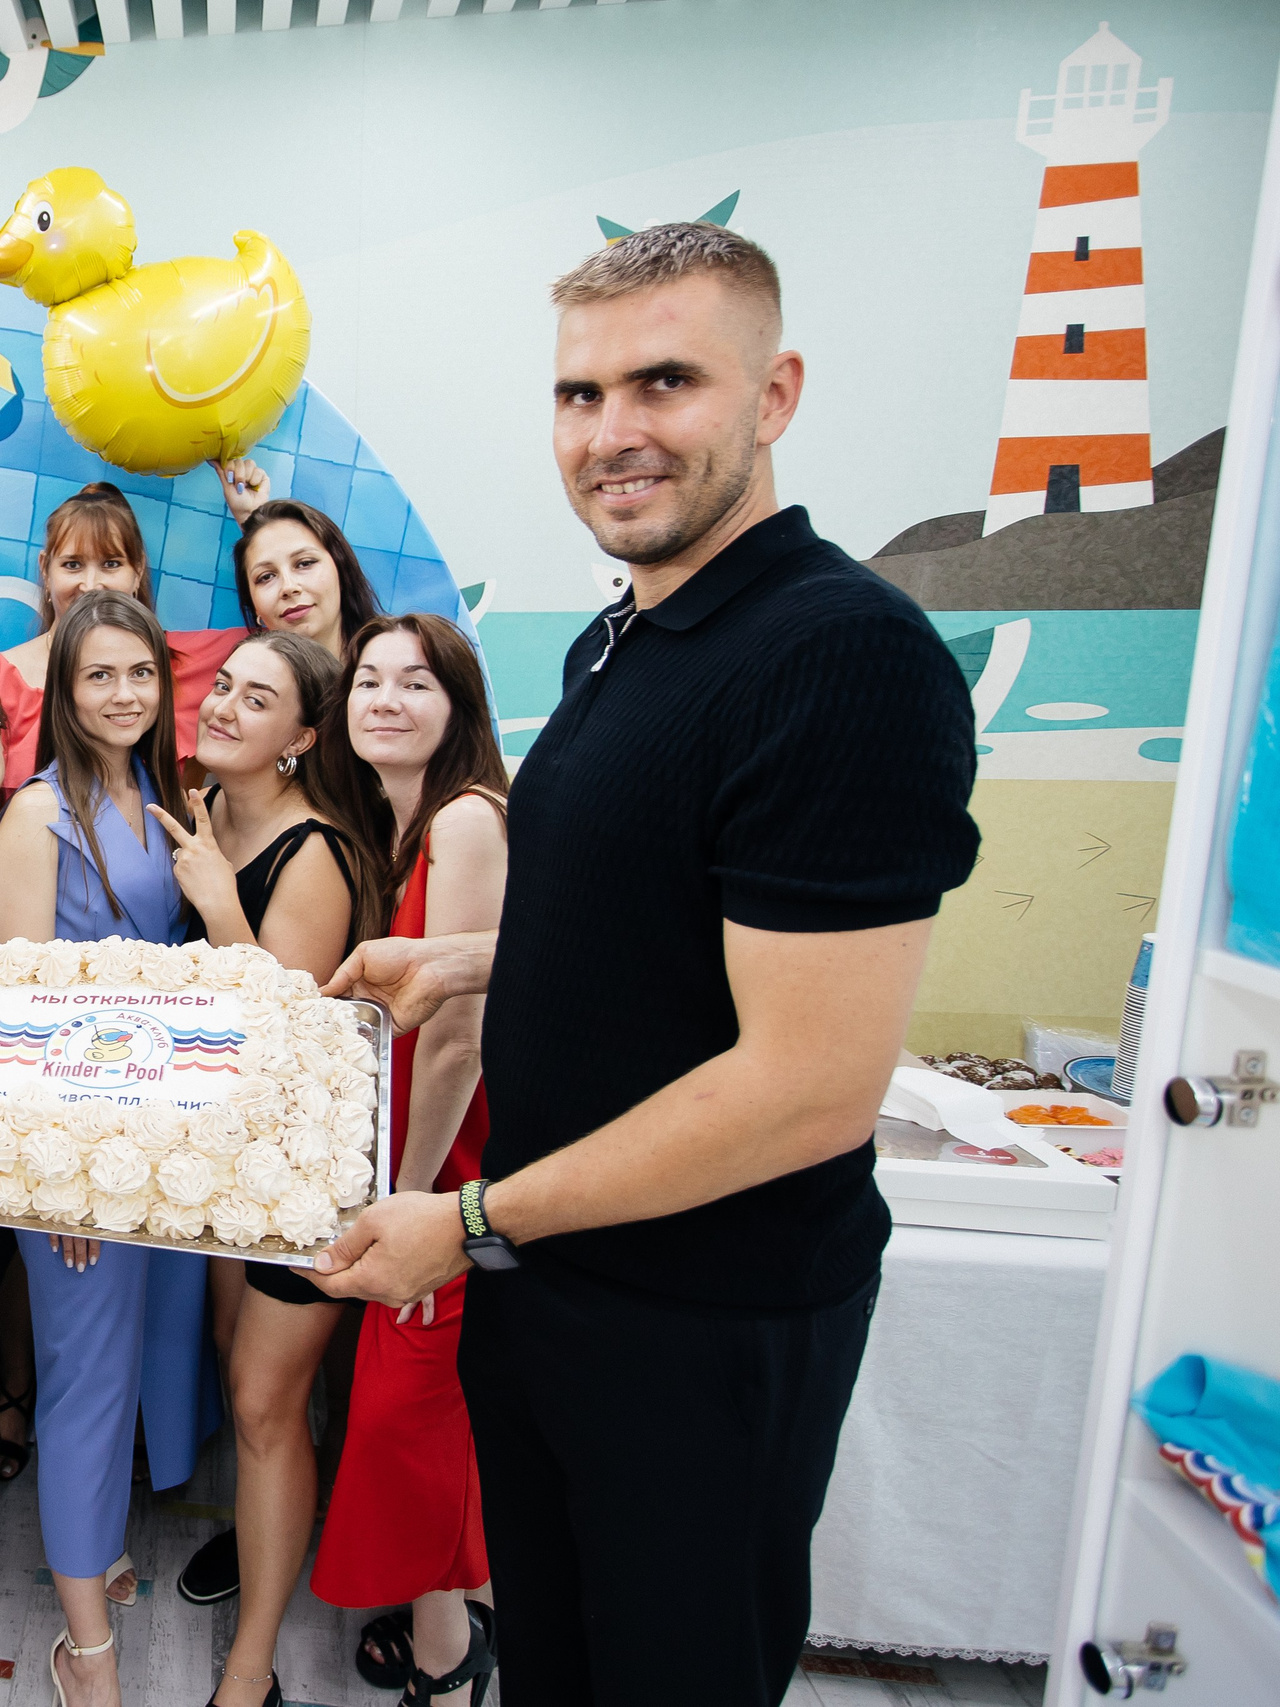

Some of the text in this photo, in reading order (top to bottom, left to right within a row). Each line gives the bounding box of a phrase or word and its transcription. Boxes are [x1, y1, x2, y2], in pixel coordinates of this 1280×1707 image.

[30, 994, 215, 1006] МЫ ОТКРЫЛИСЬ!
[42, 1061, 165, 1081] Kinder Pool
